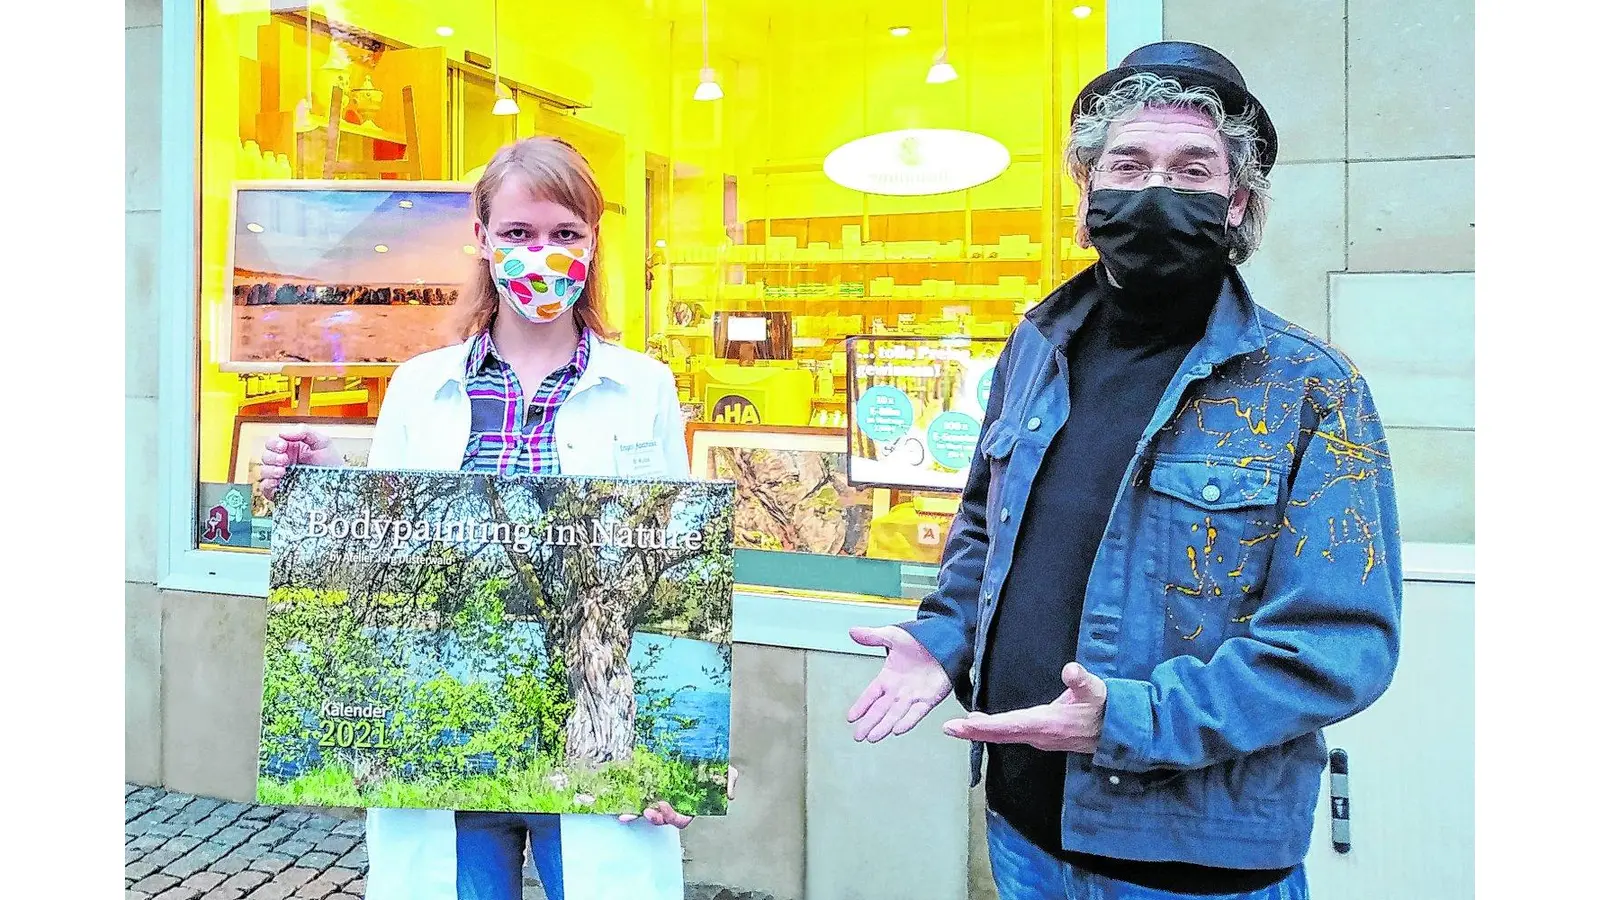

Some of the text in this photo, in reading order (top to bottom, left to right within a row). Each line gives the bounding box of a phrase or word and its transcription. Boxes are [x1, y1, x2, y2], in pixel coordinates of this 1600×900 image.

[307, 509, 702, 553] Bodypainting in Nature
[329, 553, 341, 564] by
[344, 553, 375, 563] Atelier
[322, 702, 387, 718] Kalender
[319, 720, 391, 749] 2021
